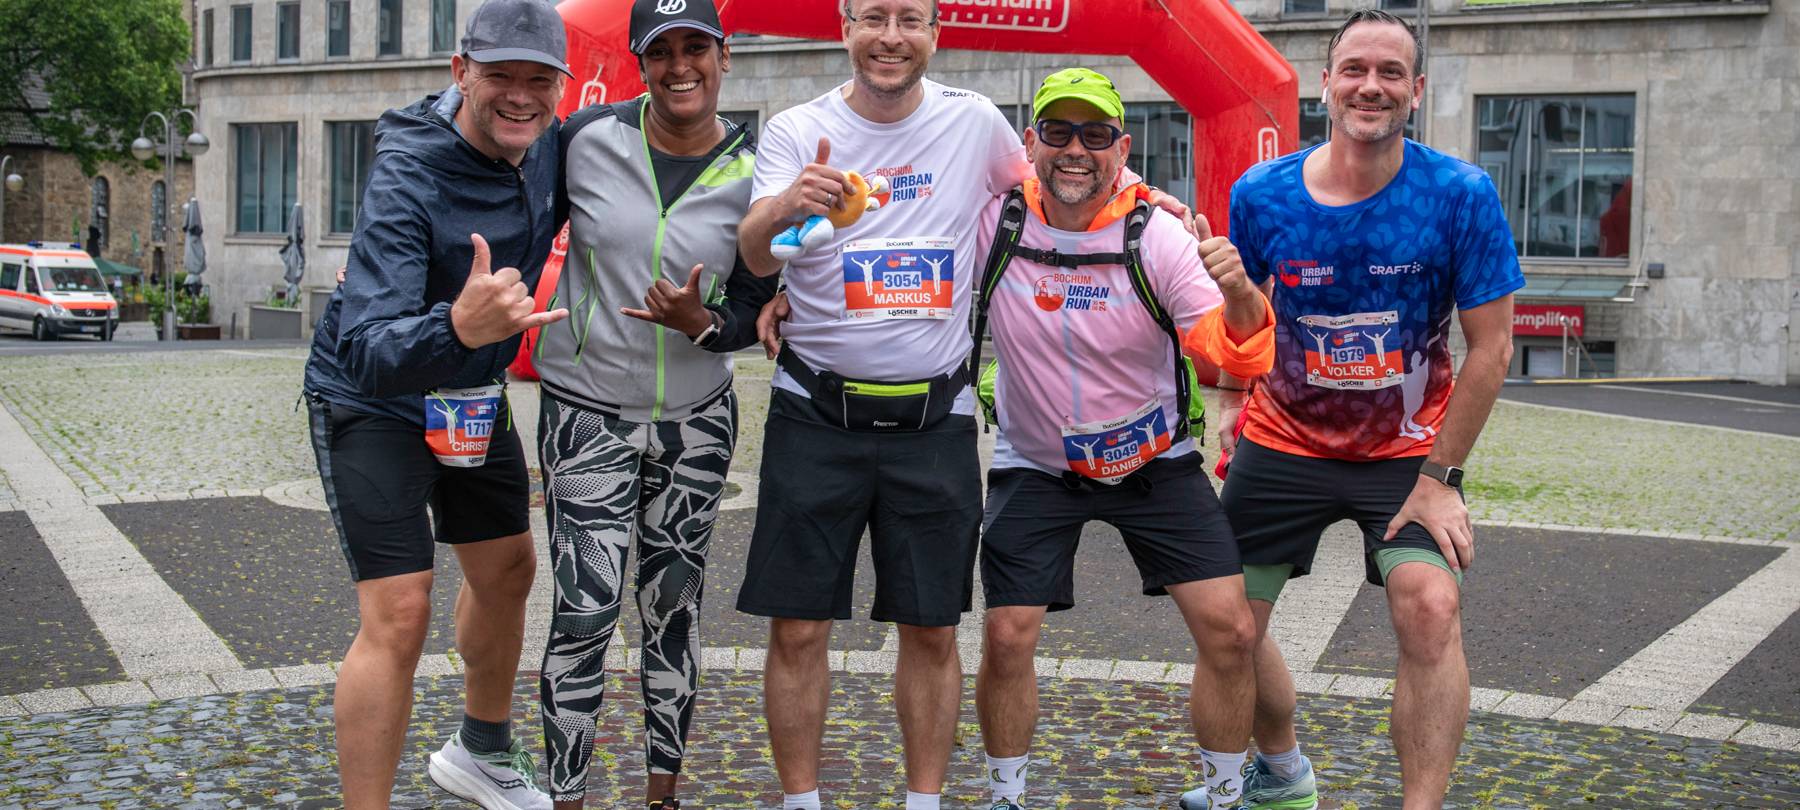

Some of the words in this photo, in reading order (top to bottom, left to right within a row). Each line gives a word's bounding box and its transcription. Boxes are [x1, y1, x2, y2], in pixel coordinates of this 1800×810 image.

[876, 164, 913, 177] BOCHUM
[892, 173, 932, 189] URBAN
[892, 187, 917, 202] RUN
[1301, 265, 1334, 277] URBAN
[1369, 264, 1411, 275] CRAFT
[884, 274, 921, 288] 3054
[1054, 273, 1092, 285] BOCHUM
[1301, 277, 1322, 286] RUN
[874, 292, 932, 305] MARKUS
[1067, 285, 1110, 299] URBAN
[1065, 298, 1092, 310] RUN
[1512, 311, 1581, 329] amplifon
[1332, 349, 1365, 362] 1979
[1327, 365, 1376, 376] VOLKER
[466, 421, 492, 436] 1717
[1104, 442, 1139, 463] 3049
[1101, 456, 1146, 475] DANIEL
